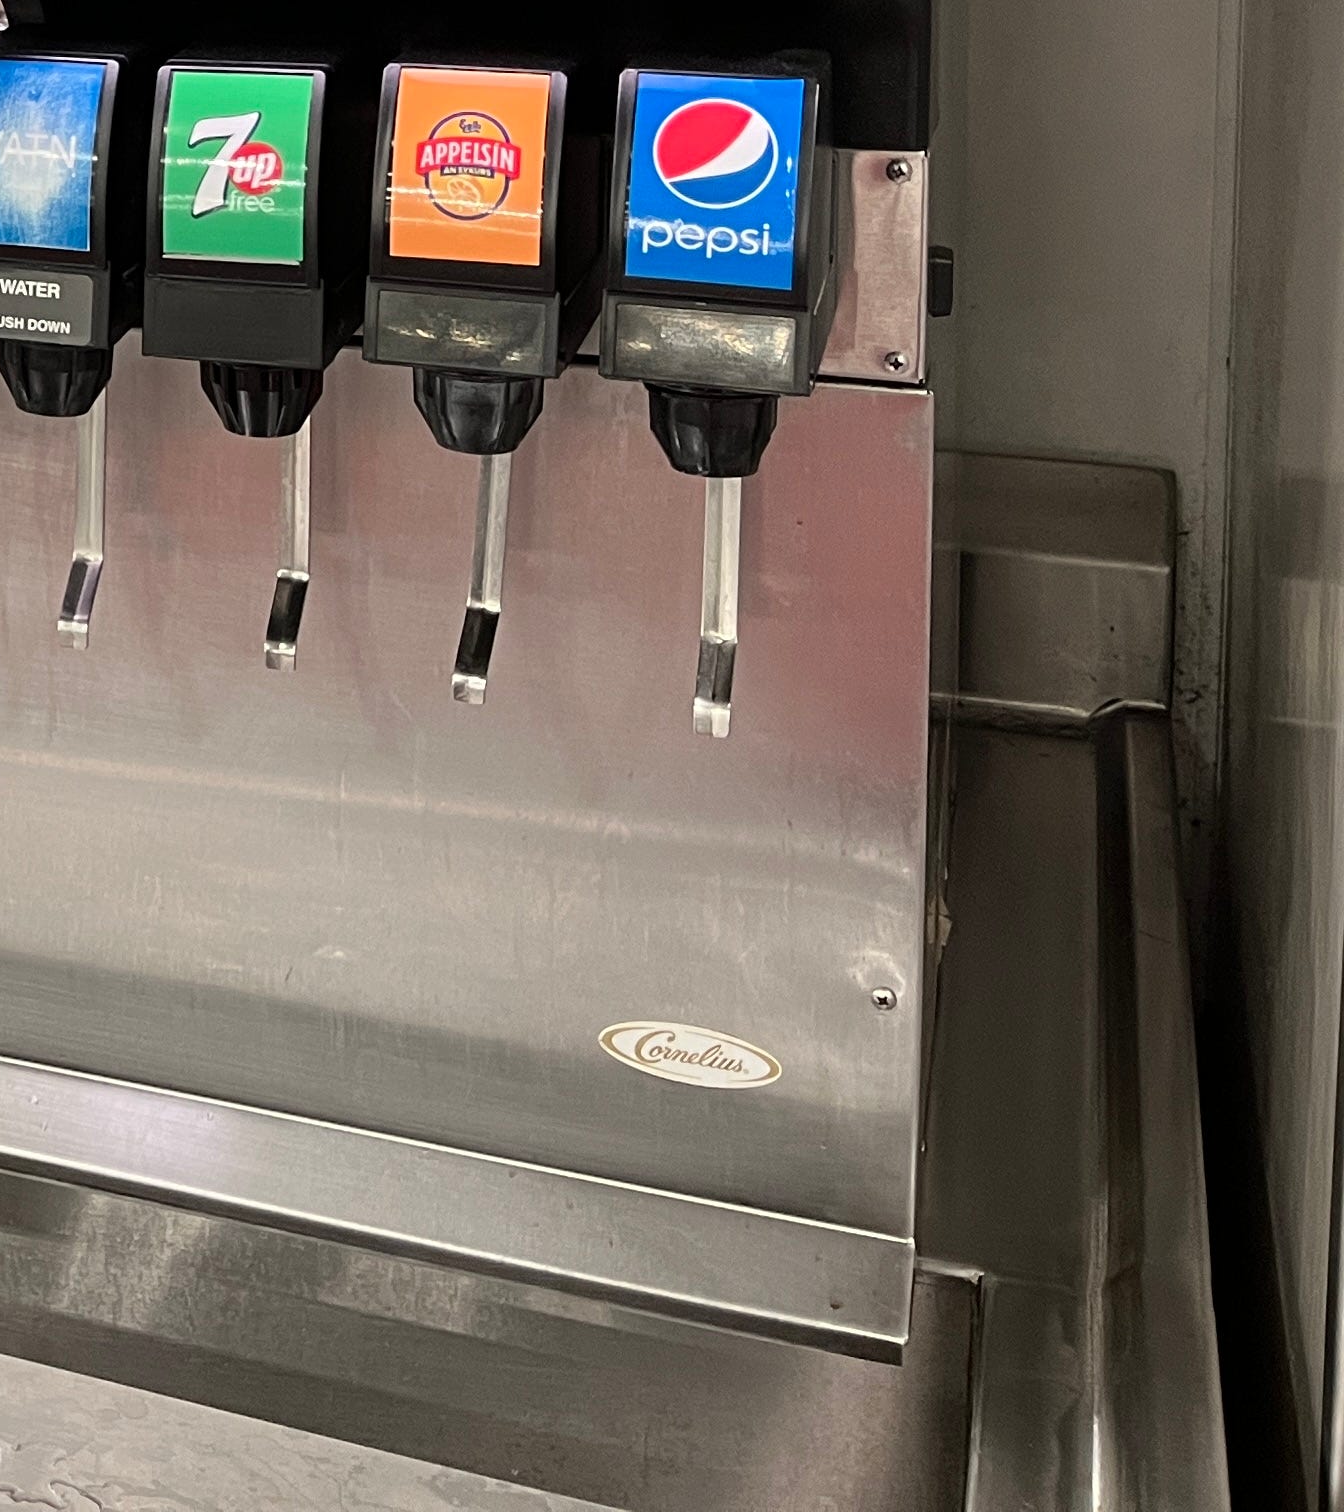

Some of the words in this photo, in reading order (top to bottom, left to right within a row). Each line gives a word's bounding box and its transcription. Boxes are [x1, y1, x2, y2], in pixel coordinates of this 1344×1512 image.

[229, 191, 275, 213] free
[642, 221, 770, 259] pepsi
[0, 277, 61, 299] WATER
[27, 318, 71, 335] DOWN
[634, 1030, 745, 1074] Cornelius
